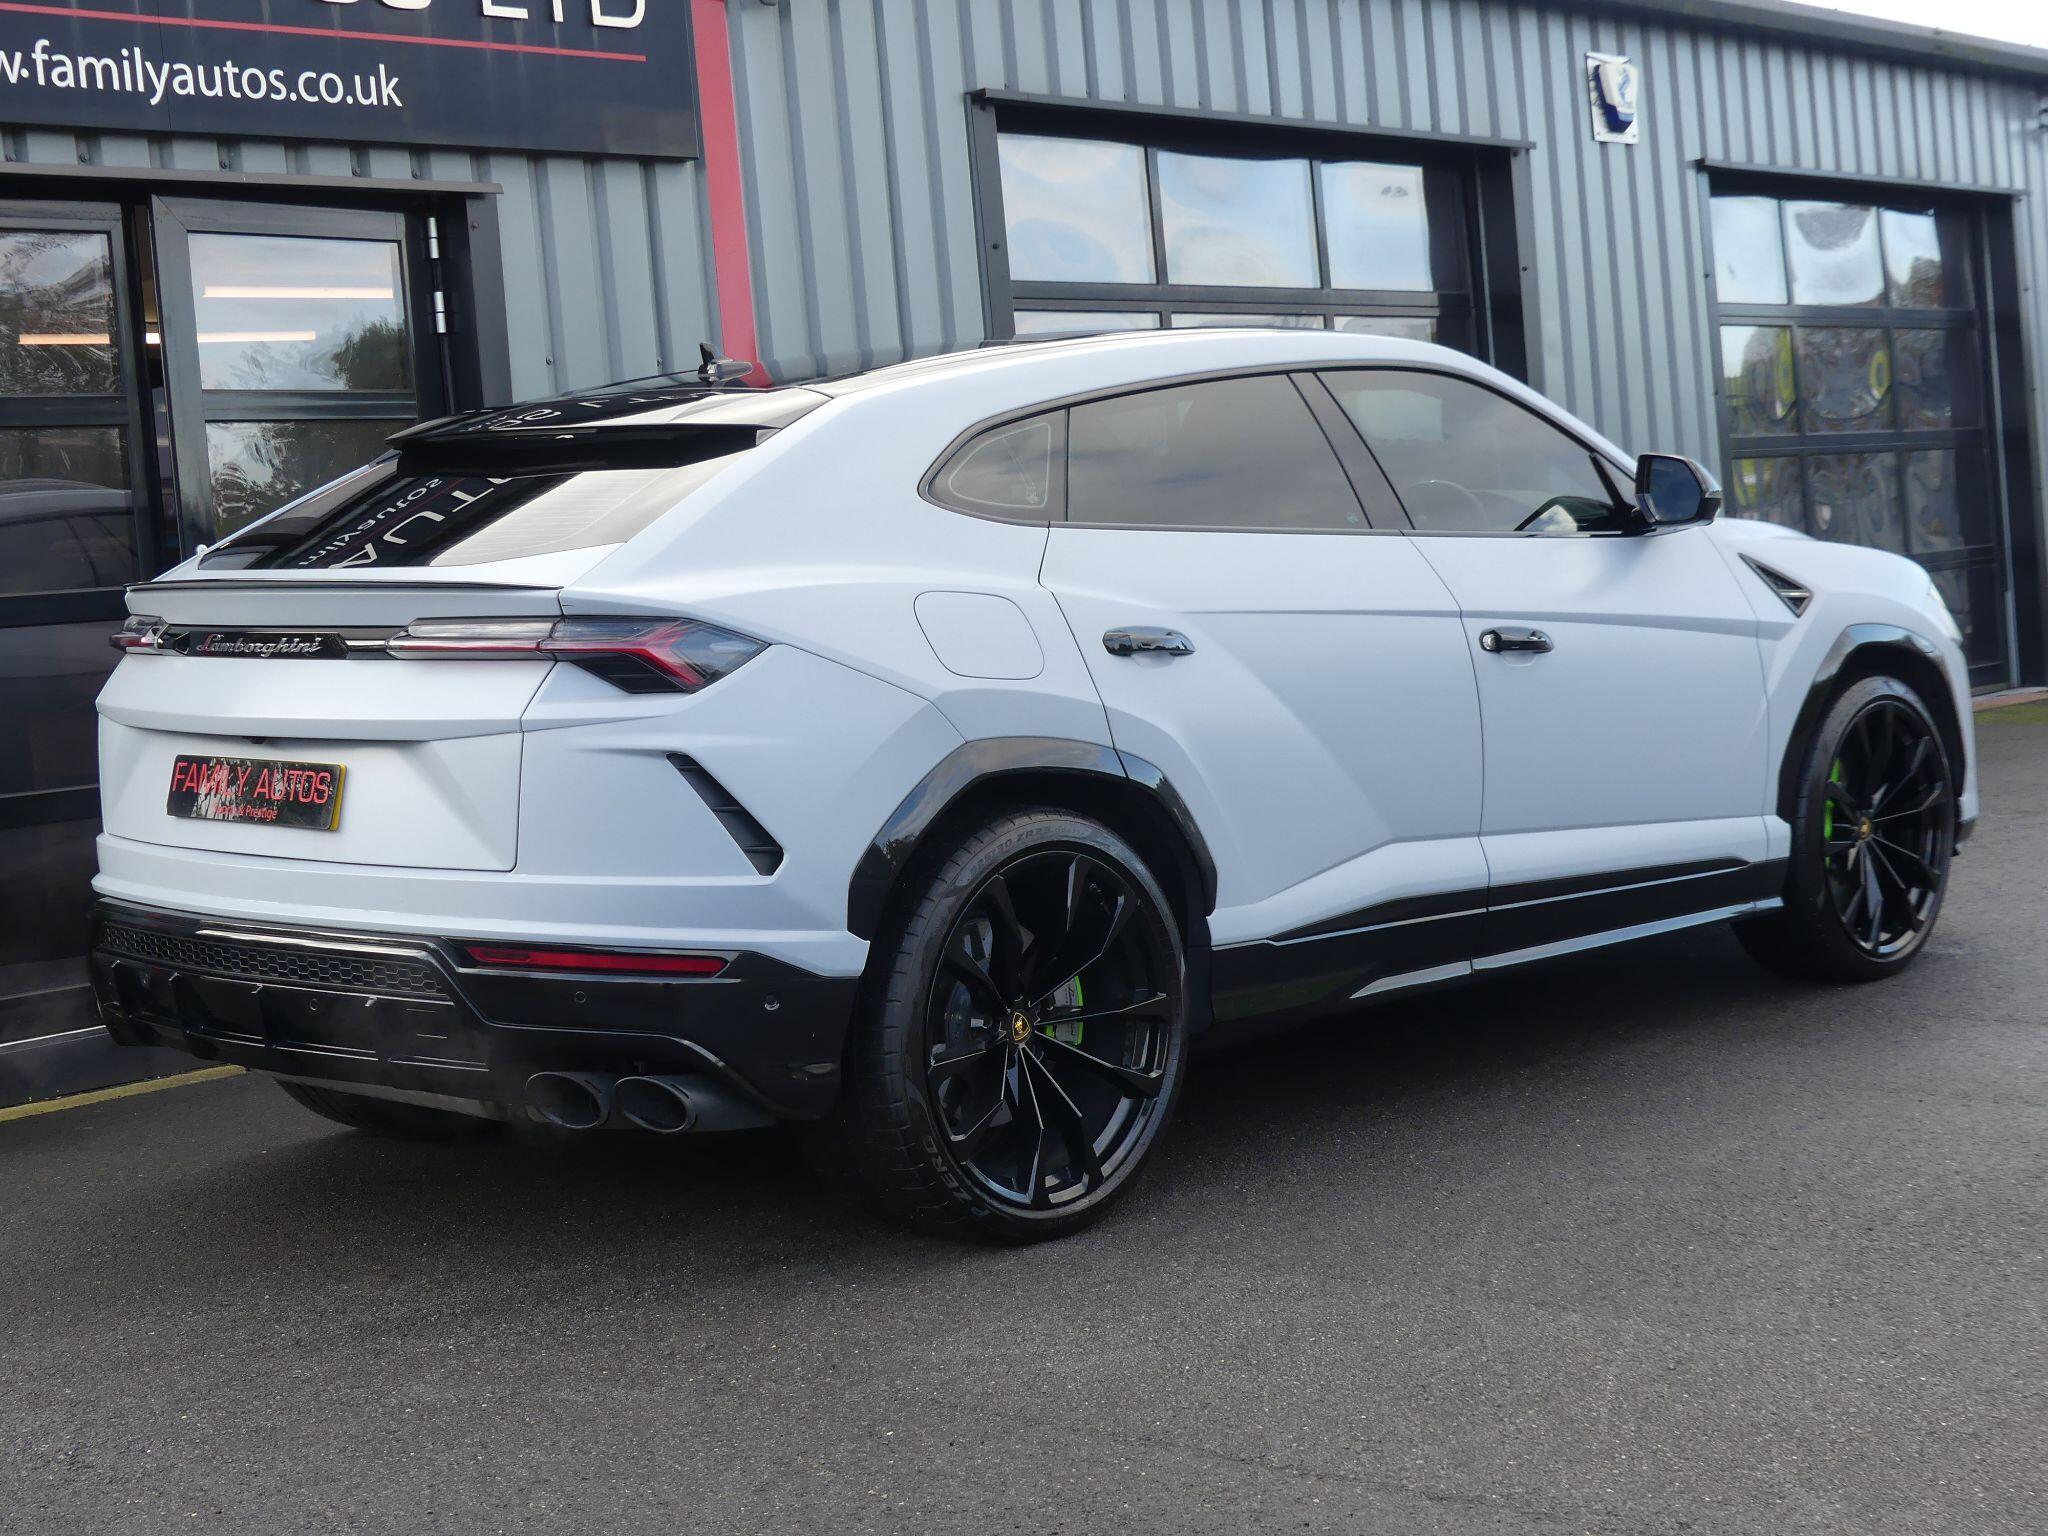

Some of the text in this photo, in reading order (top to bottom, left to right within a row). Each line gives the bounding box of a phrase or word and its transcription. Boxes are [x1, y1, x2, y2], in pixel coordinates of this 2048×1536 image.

[196, 633, 323, 657] Lamborghini
[171, 762, 332, 804] FAMILY AUTOS
[246, 804, 278, 821] Prestige
